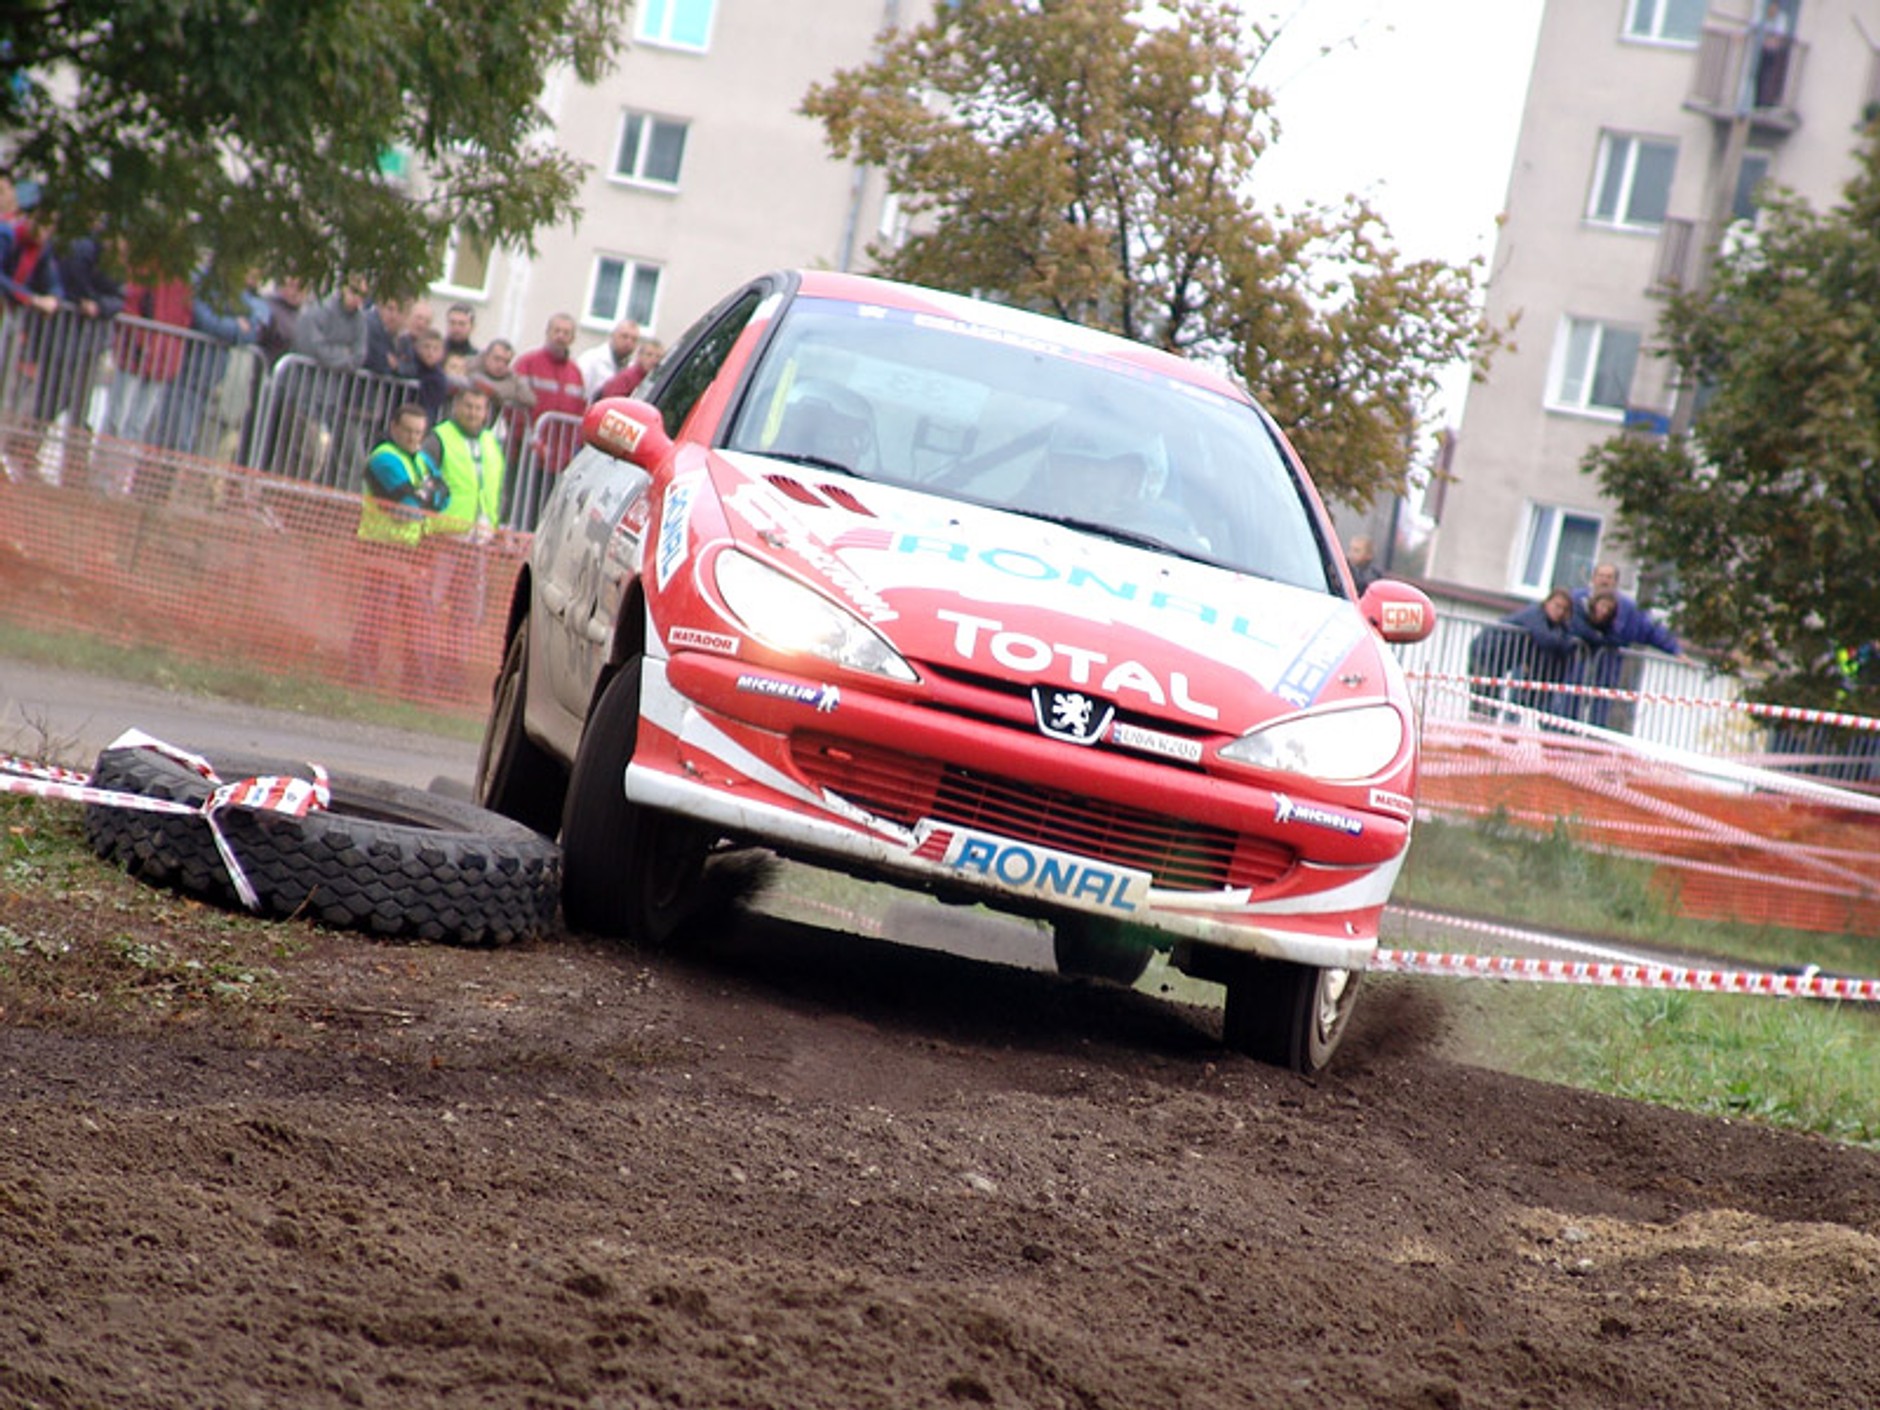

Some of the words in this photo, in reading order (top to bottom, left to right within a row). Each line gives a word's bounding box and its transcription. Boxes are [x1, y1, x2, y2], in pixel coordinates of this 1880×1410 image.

[898, 535, 1279, 649] RONAL
[672, 630, 733, 650] MATADOR
[937, 608, 1219, 721] TOTAL
[737, 675, 817, 700] MICHELIN
[1294, 804, 1363, 833] MICHELIN
[952, 837, 1137, 912] RONAL
